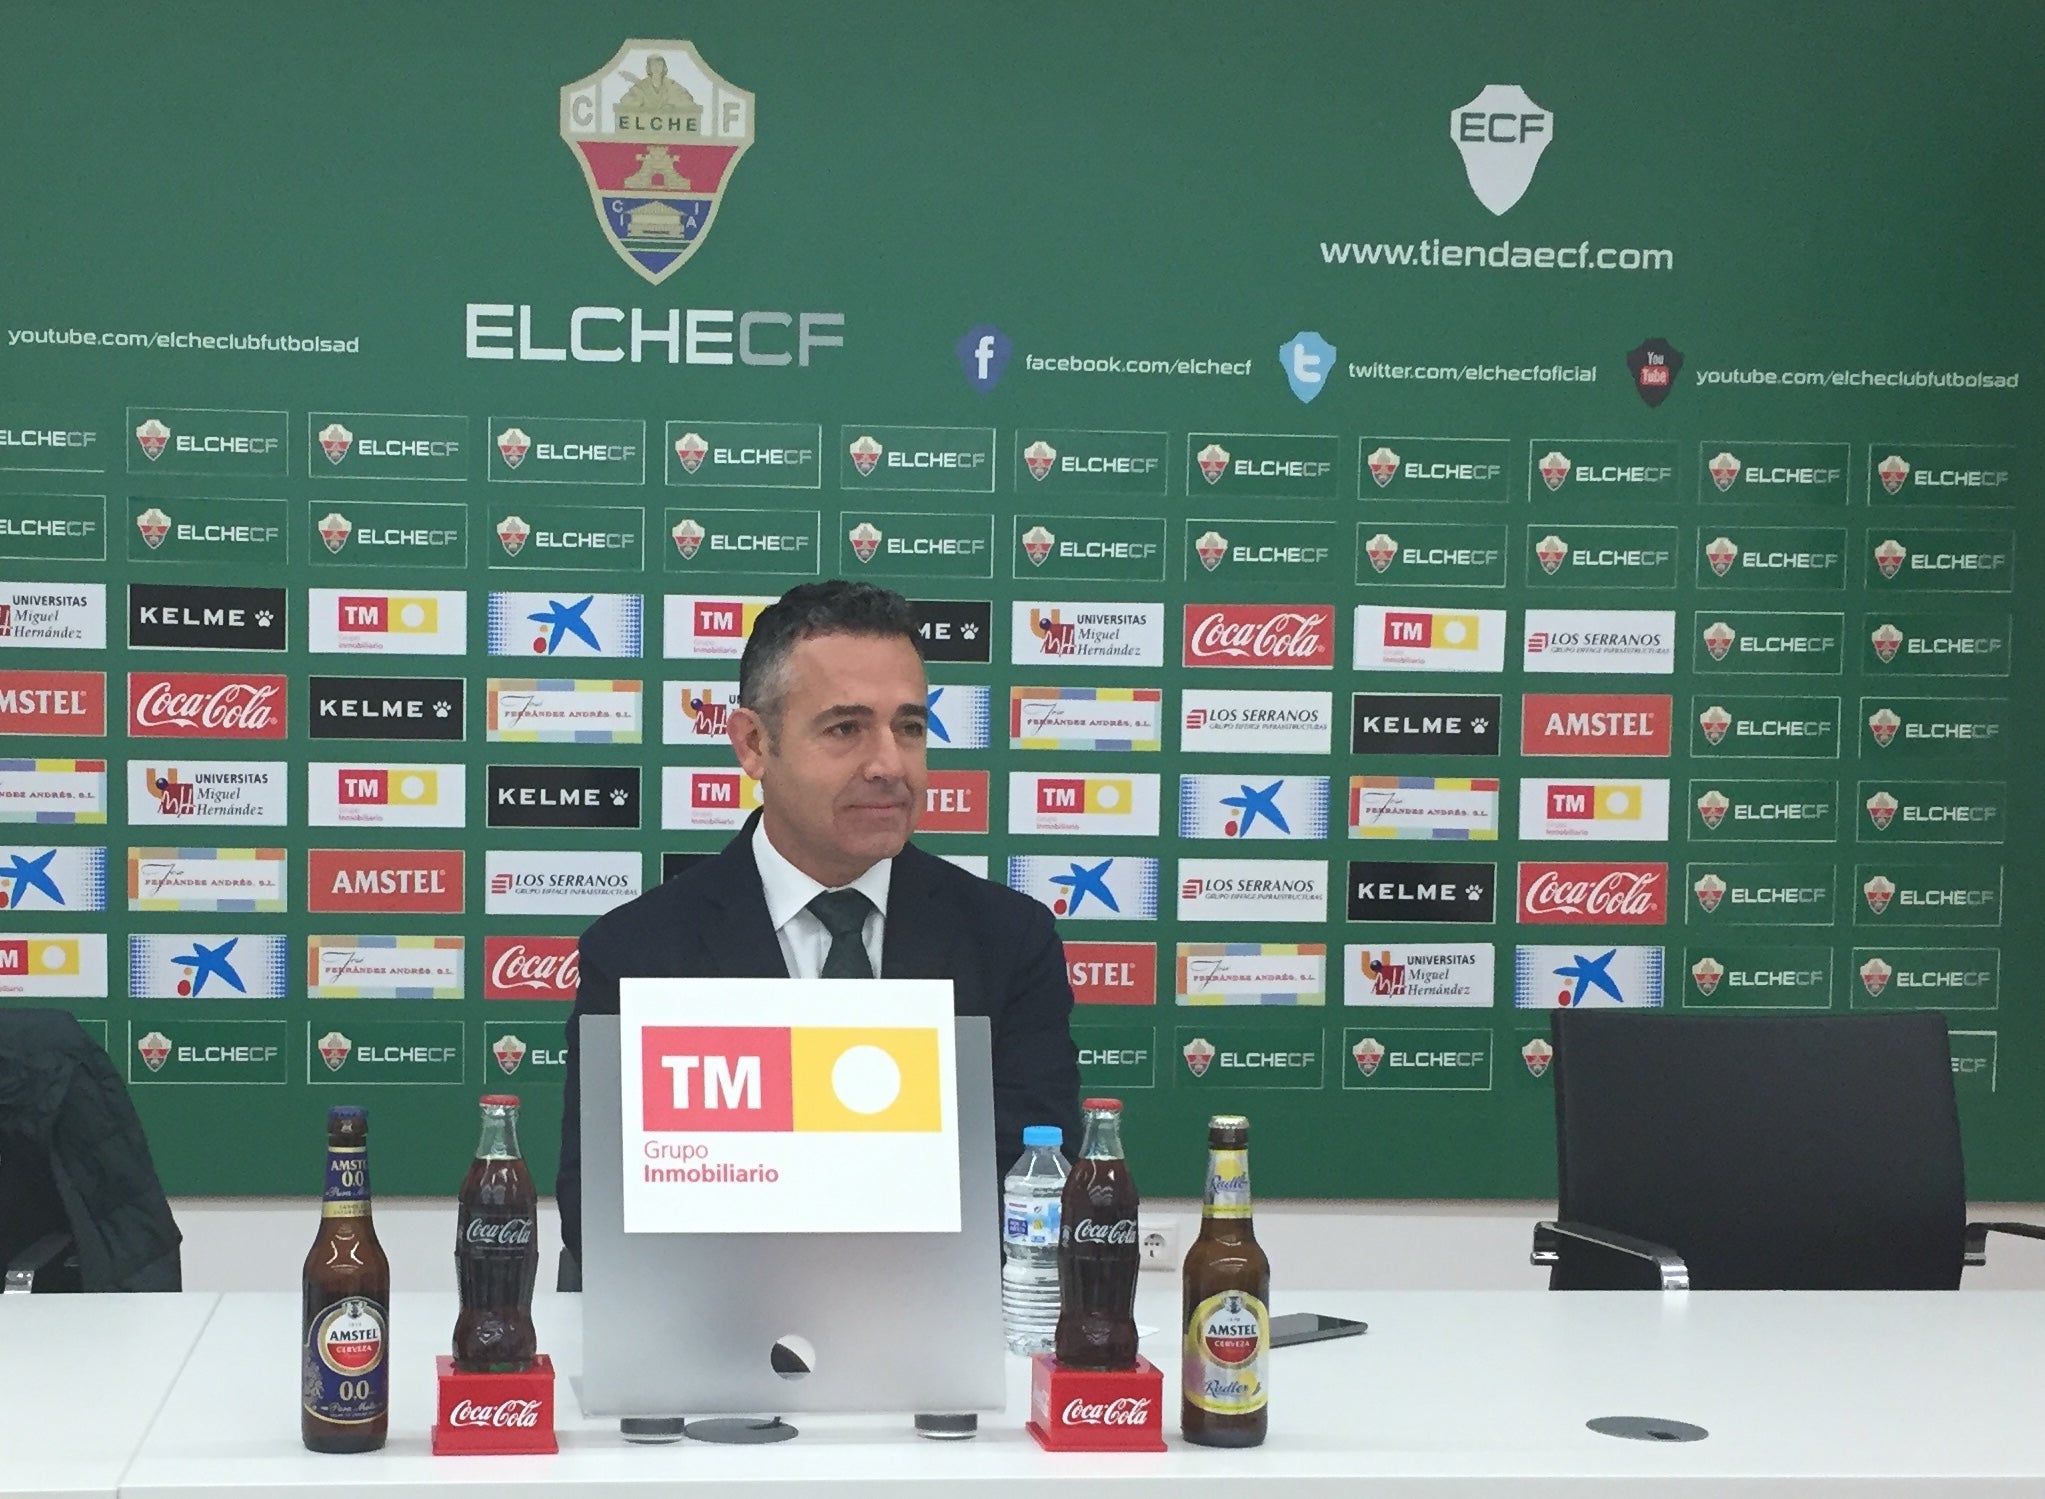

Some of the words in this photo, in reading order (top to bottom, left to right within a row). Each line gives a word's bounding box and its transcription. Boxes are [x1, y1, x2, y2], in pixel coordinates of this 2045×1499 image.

[618, 116, 698, 132] ELCHE
[1460, 111, 1546, 144] ECF
[1320, 239, 1674, 271] www.tiendaecf.com
[7, 326, 360, 355] youtube.com/elcheclubfutbolsad
[1025, 353, 1252, 378] facebook.com/elchecf
[1647, 351, 1665, 365] You
[1348, 361, 1597, 384] twitter.com/elchecfoficial
[1697, 368, 2019, 390] youtube.com/elcheclubfutbolsad
[13, 595, 87, 607] UNIVERSITAS
[15, 609, 59, 625] Miguel
[140, 607, 245, 627] KELME
[345, 606, 378, 625] TM
[701, 611, 733, 630] TM
[1077, 614, 1147, 625] UNIVERSITAS
[14, 626, 82, 639] Hernández
[1078, 628, 1119, 643] Miguel
[1192, 612, 1328, 659] Coca-Cola
[1391, 621, 1423, 641] TM
[1551, 633, 1579, 645] LOS
[1584, 633, 1661, 646] SERRANOS
[1077, 644, 1141, 656] Hernández
[0, 690, 86, 714] MSTEL
[137, 682, 279, 729] Coca-Cola
[320, 700, 423, 718] KELME
[1209, 709, 1237, 721] LOS
[1243, 709, 1319, 722] SERRANOS
[1363, 716, 1462, 734] KELME
[1544, 712, 1654, 736] AMSTEL
[195, 773, 268, 784] UNIVERSITAS
[197, 787, 240, 802] Miguel
[345, 779, 378, 798] TM
[499, 788, 600, 806] KELME
[698, 782, 731, 802] TM
[1043, 788, 1075, 807] TM
[926, 788, 971, 812] TEL
[1553, 794, 1585, 813] TM
[197, 804, 263, 816] Hernández
[331, 869, 446, 894] AMSTEL
[515, 873, 545, 886] LOS
[550, 874, 628, 887] SERRANOS
[1205, 879, 1233, 892] LOS
[1237, 879, 1315, 892] SERRANOS
[1358, 883, 1456, 901] KELME
[1525, 871, 1660, 915] Coca-Cola
[0, 949, 18, 968] M
[1407, 955, 1476, 965] UNIVERSITAS
[1066, 962, 1135, 986] STEL
[1408, 968, 1449, 983] Miguel
[1408, 983, 1470, 996] Hernández
[1076, 1049, 1147, 1065] CHECF
[661, 1055, 761, 1109] TM
[643, 1140, 709, 1164] Grupo
[644, 1163, 779, 1183] Inmobiliario
[467, 1218, 532, 1243] Coca-Cola
[1074, 1219, 1136, 1244] Coca-Cola
[330, 1329, 377, 1341] AMSTEL
[1208, 1324, 1256, 1336] AMSTEL
[335, 1344, 373, 1353] CERVEZA
[1214, 1340, 1250, 1348] CERVEZA
[450, 1399, 543, 1428] Coca-Cola
[1062, 1398, 1151, 1426] Coca-Cola
